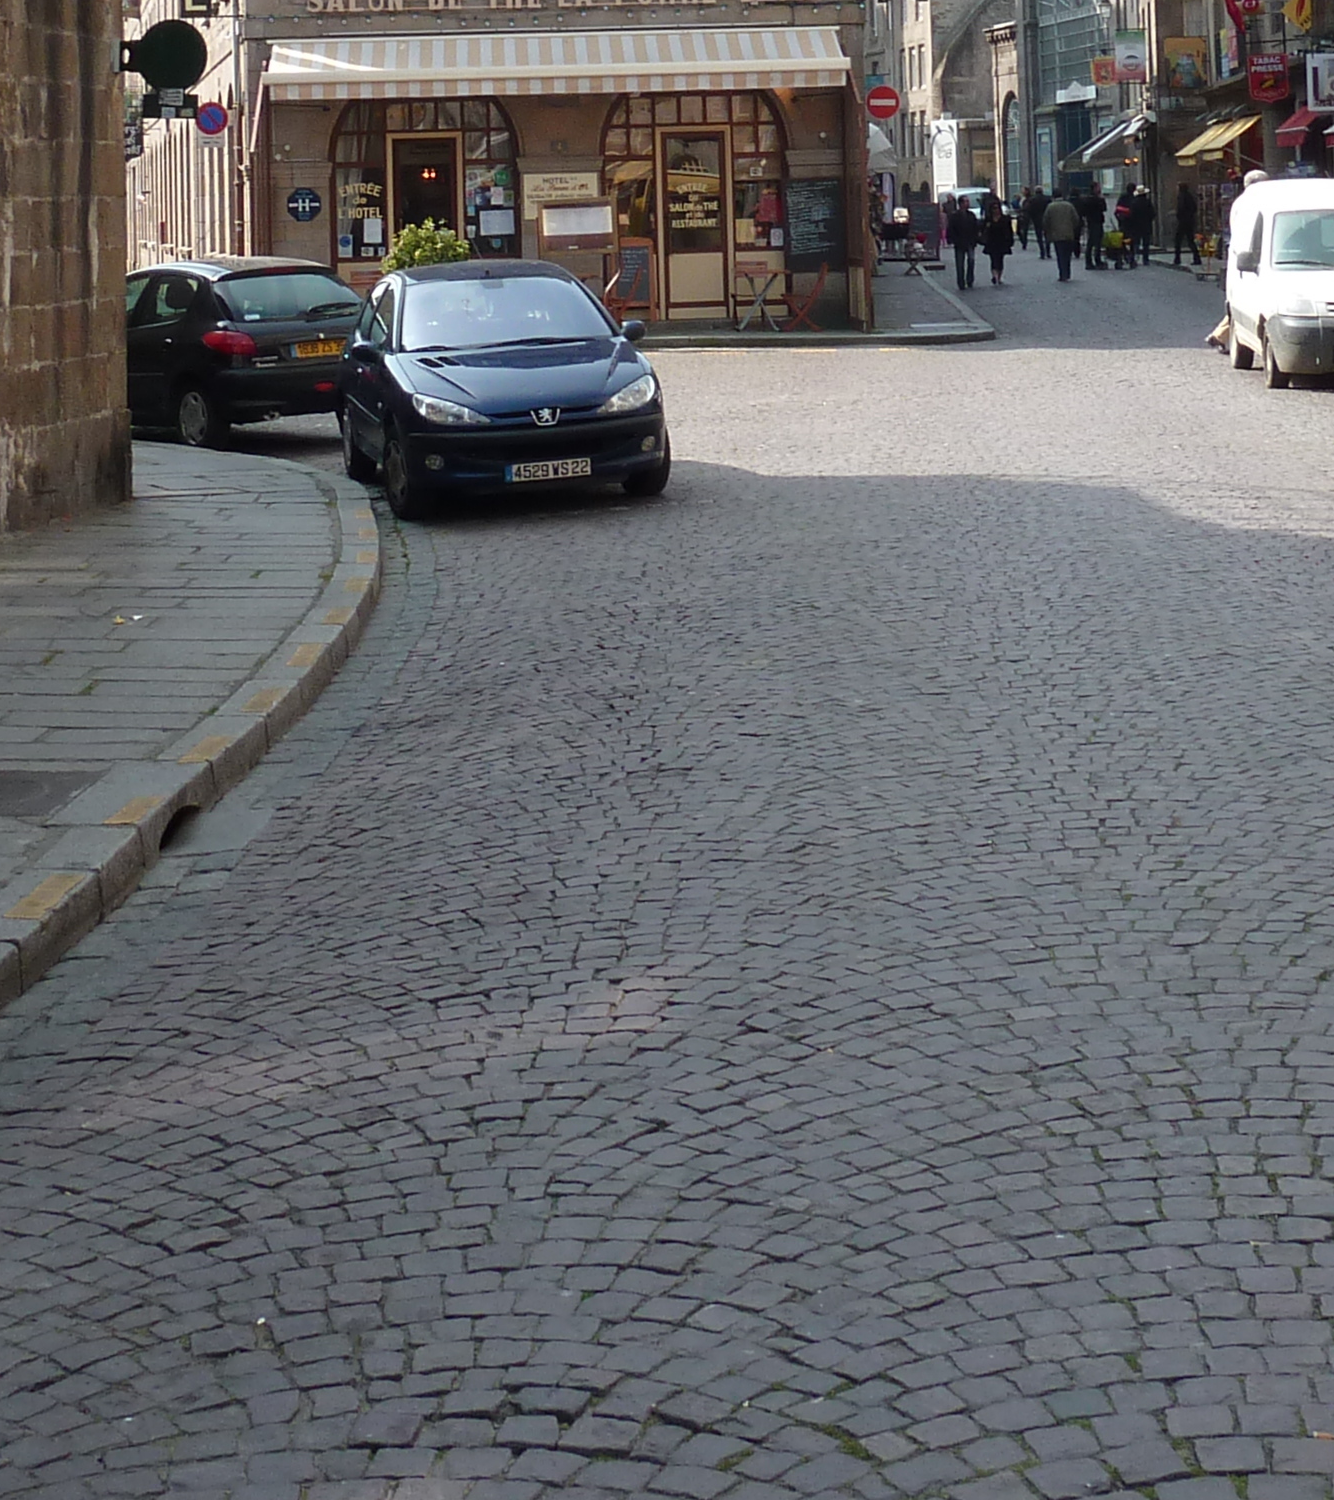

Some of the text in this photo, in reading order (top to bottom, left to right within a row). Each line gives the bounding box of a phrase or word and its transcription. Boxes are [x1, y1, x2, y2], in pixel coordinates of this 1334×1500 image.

[1253, 56, 1281, 65] TABAC
[1251, 64, 1284, 73] PRESSE
[338, 182, 383, 197] ENTRÉE
[298, 198, 310, 212] H
[352, 195, 368, 204] de
[514, 463, 549, 480] 4529
[571, 459, 589, 474] 22
